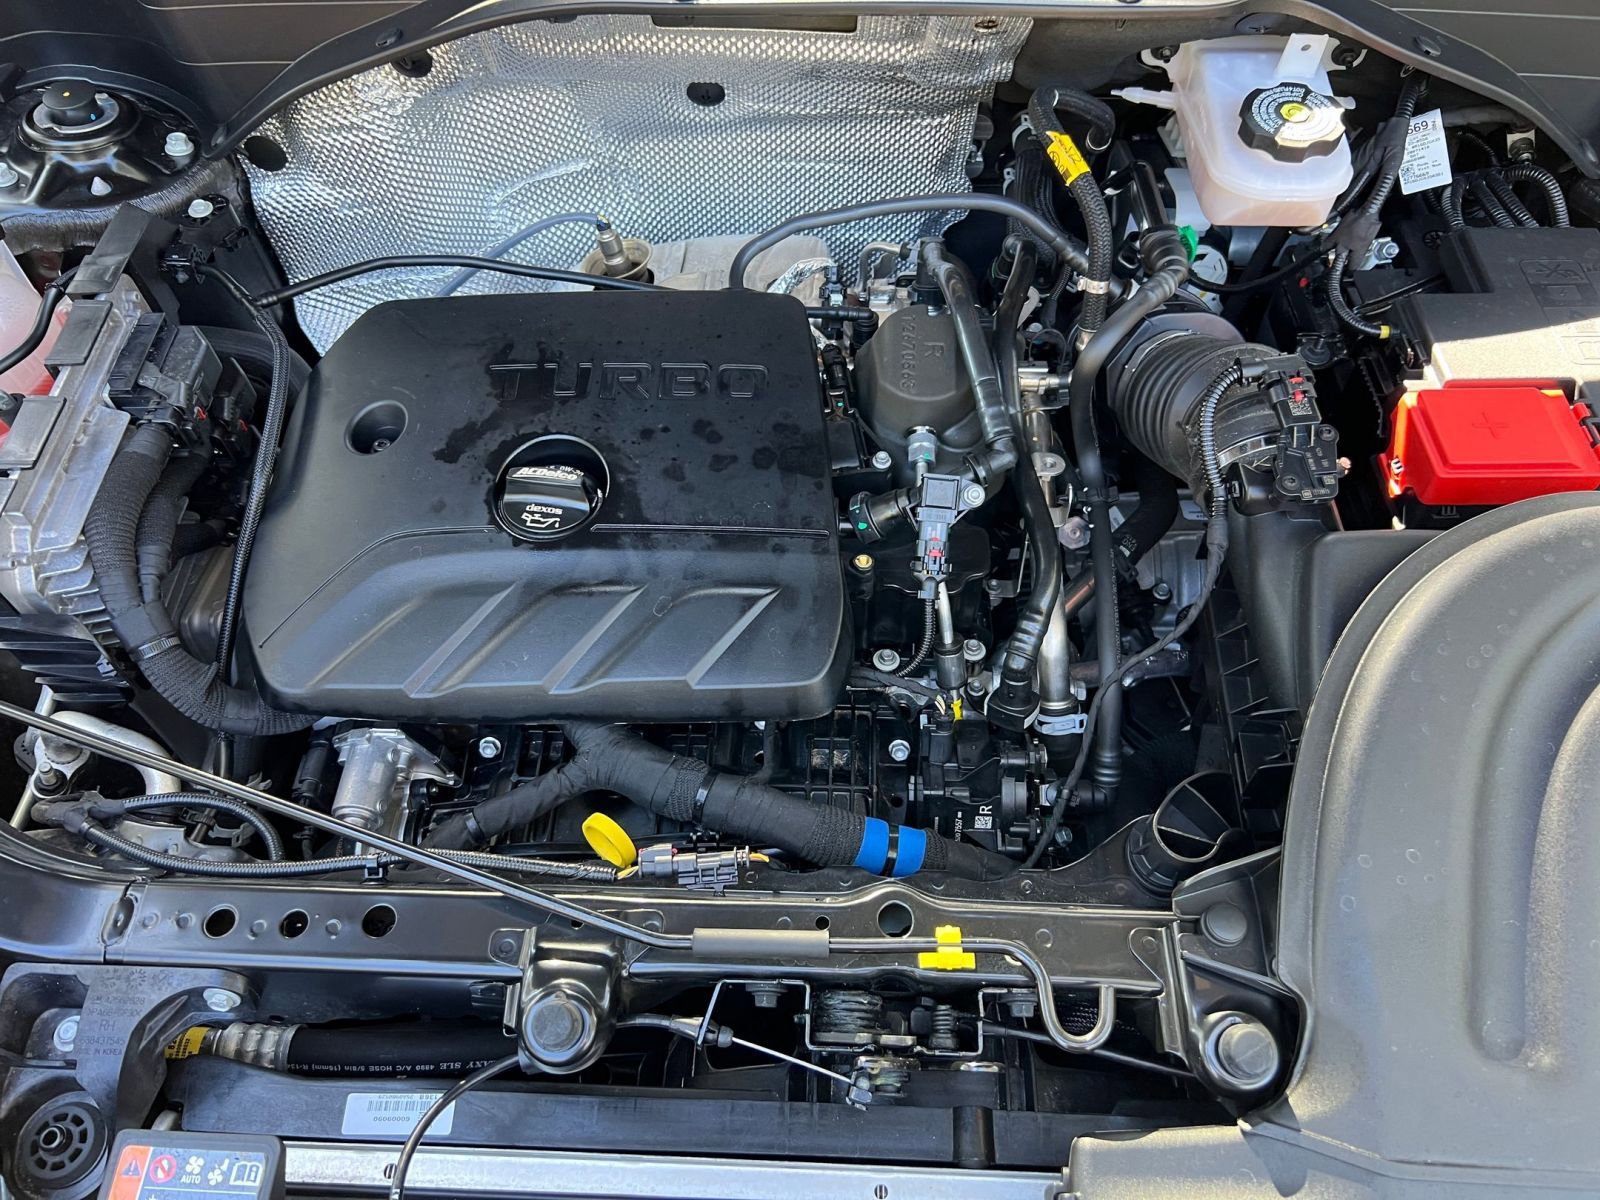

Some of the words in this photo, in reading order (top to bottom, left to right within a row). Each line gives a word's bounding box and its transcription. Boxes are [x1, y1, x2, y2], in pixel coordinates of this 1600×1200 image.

[489, 362, 769, 400] TURBO
[512, 467, 578, 480] ACDelco
[525, 503, 563, 515] dexos
[979, 805, 993, 815] R
[98, 1019, 116, 1032] RH
[368, 1064, 392, 1072] HOSE
[396, 1064, 412, 1072] A/C
[439, 1061, 462, 1070] SLE
[180, 1174, 201, 1184] AUTO
